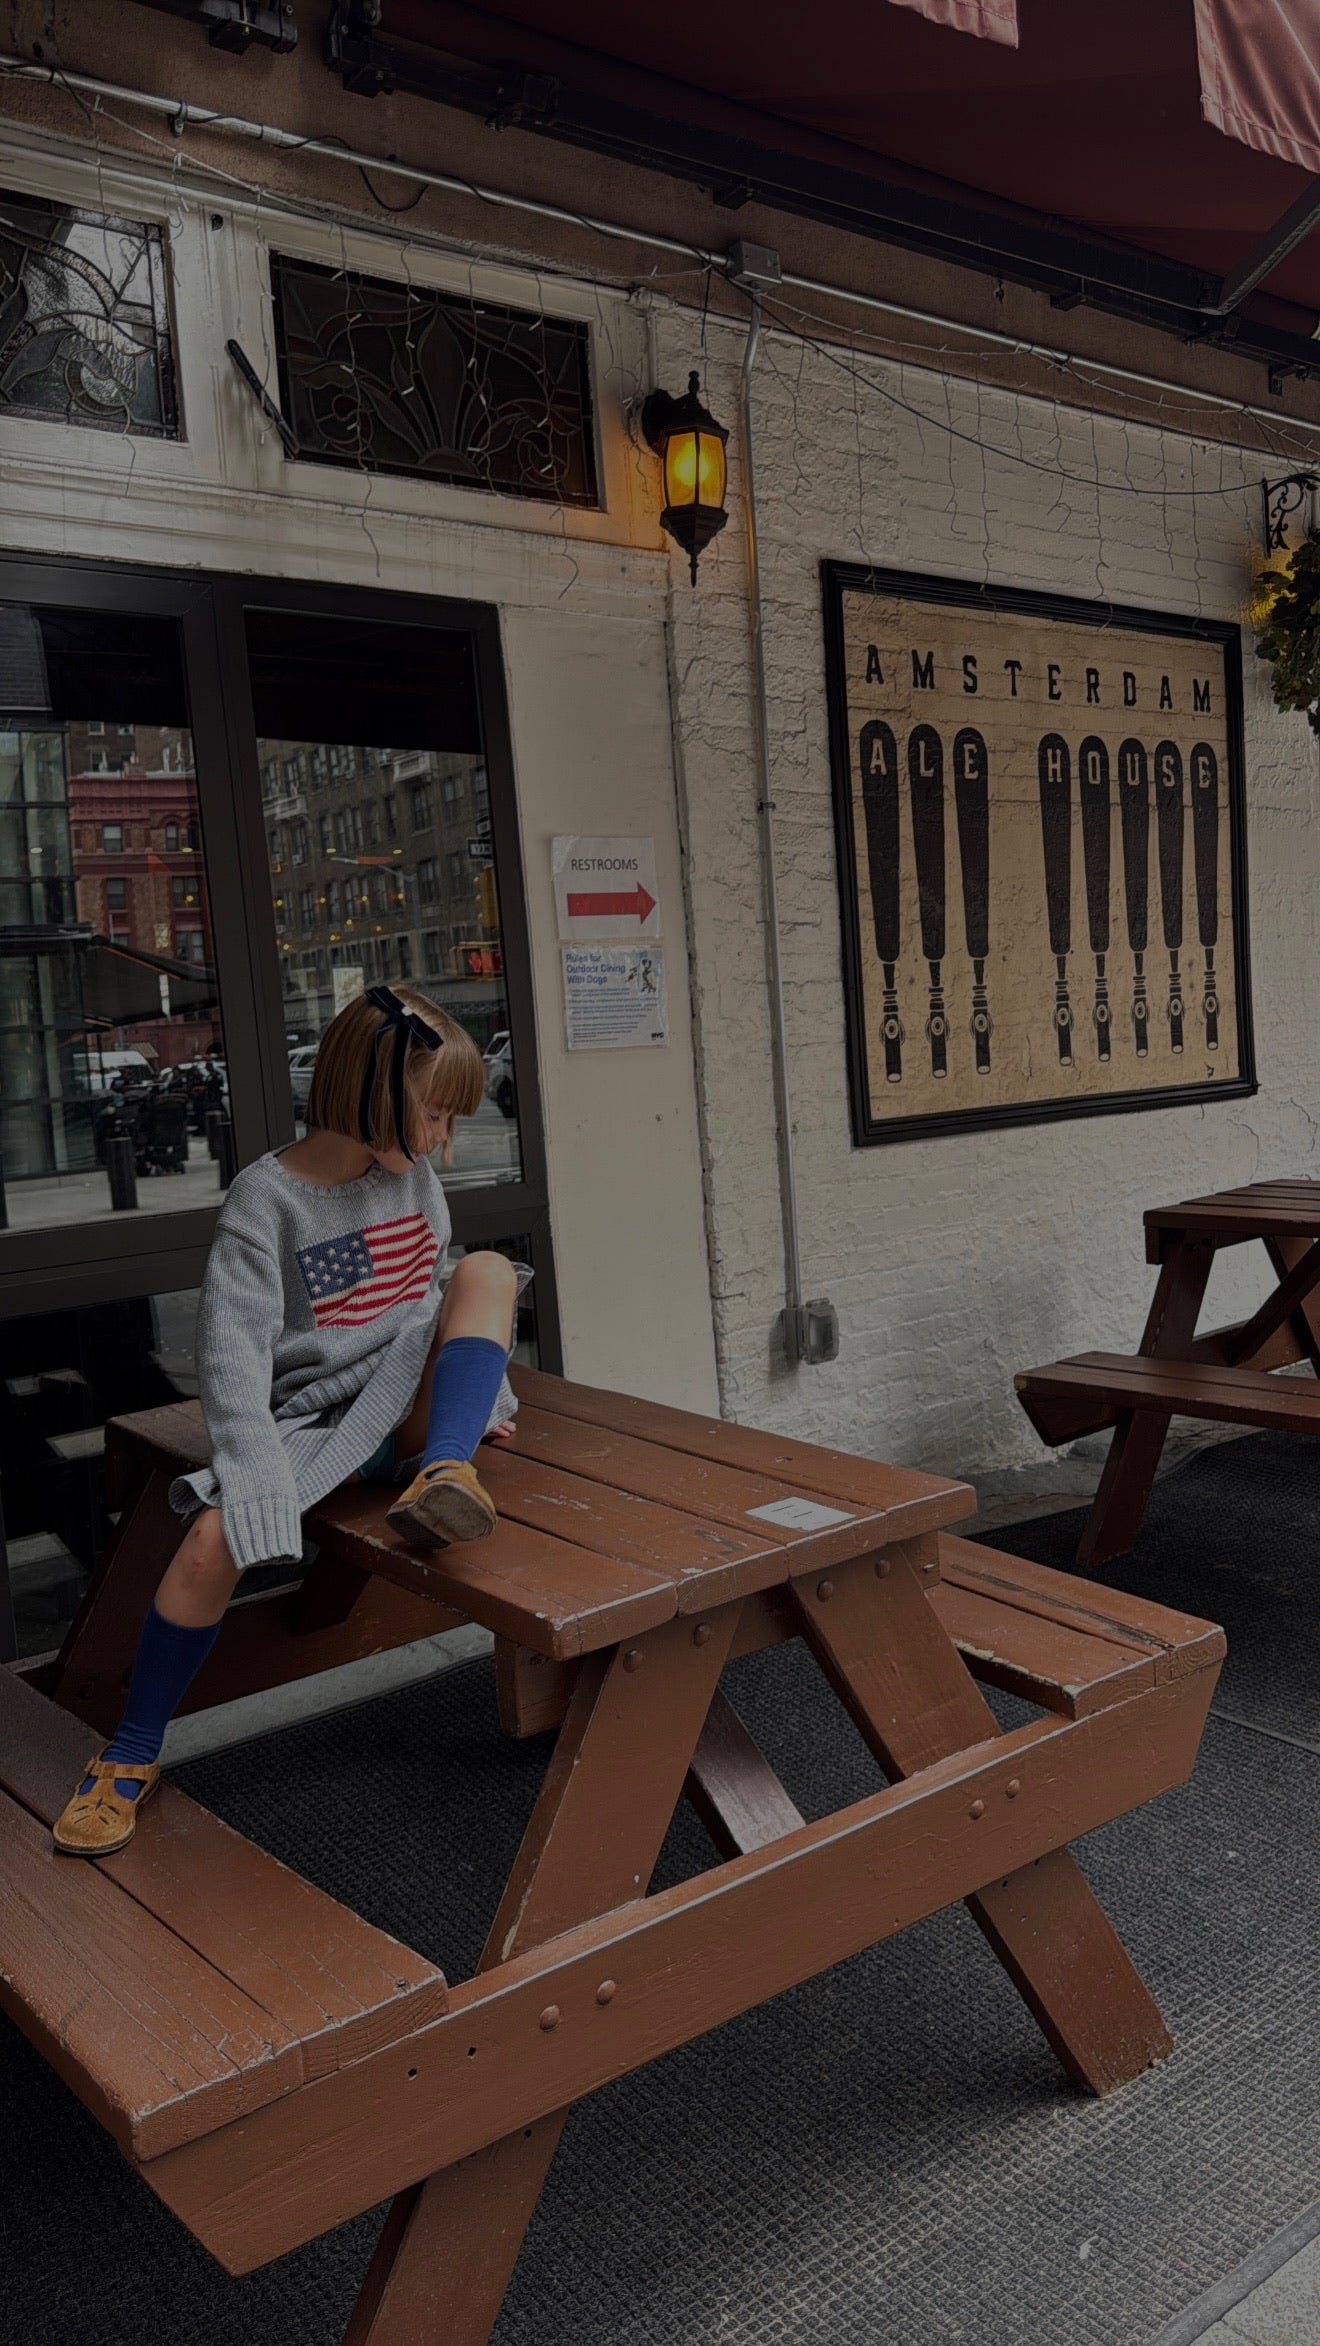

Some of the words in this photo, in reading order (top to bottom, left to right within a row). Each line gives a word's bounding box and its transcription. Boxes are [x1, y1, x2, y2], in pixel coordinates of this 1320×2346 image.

[865, 644, 1211, 713] AMSTERDAM
[869, 738, 979, 780] ALE
[1047, 747, 1211, 789] HOUSE
[570, 858, 638, 871] RESTROOMS
[566, 953, 588, 962] Rules
[590, 953, 601, 962] for
[566, 963, 598, 973] Outdoor
[600, 963, 626, 974] Dining
[566, 975, 585, 984] With
[586, 975, 608, 985] Dogs
